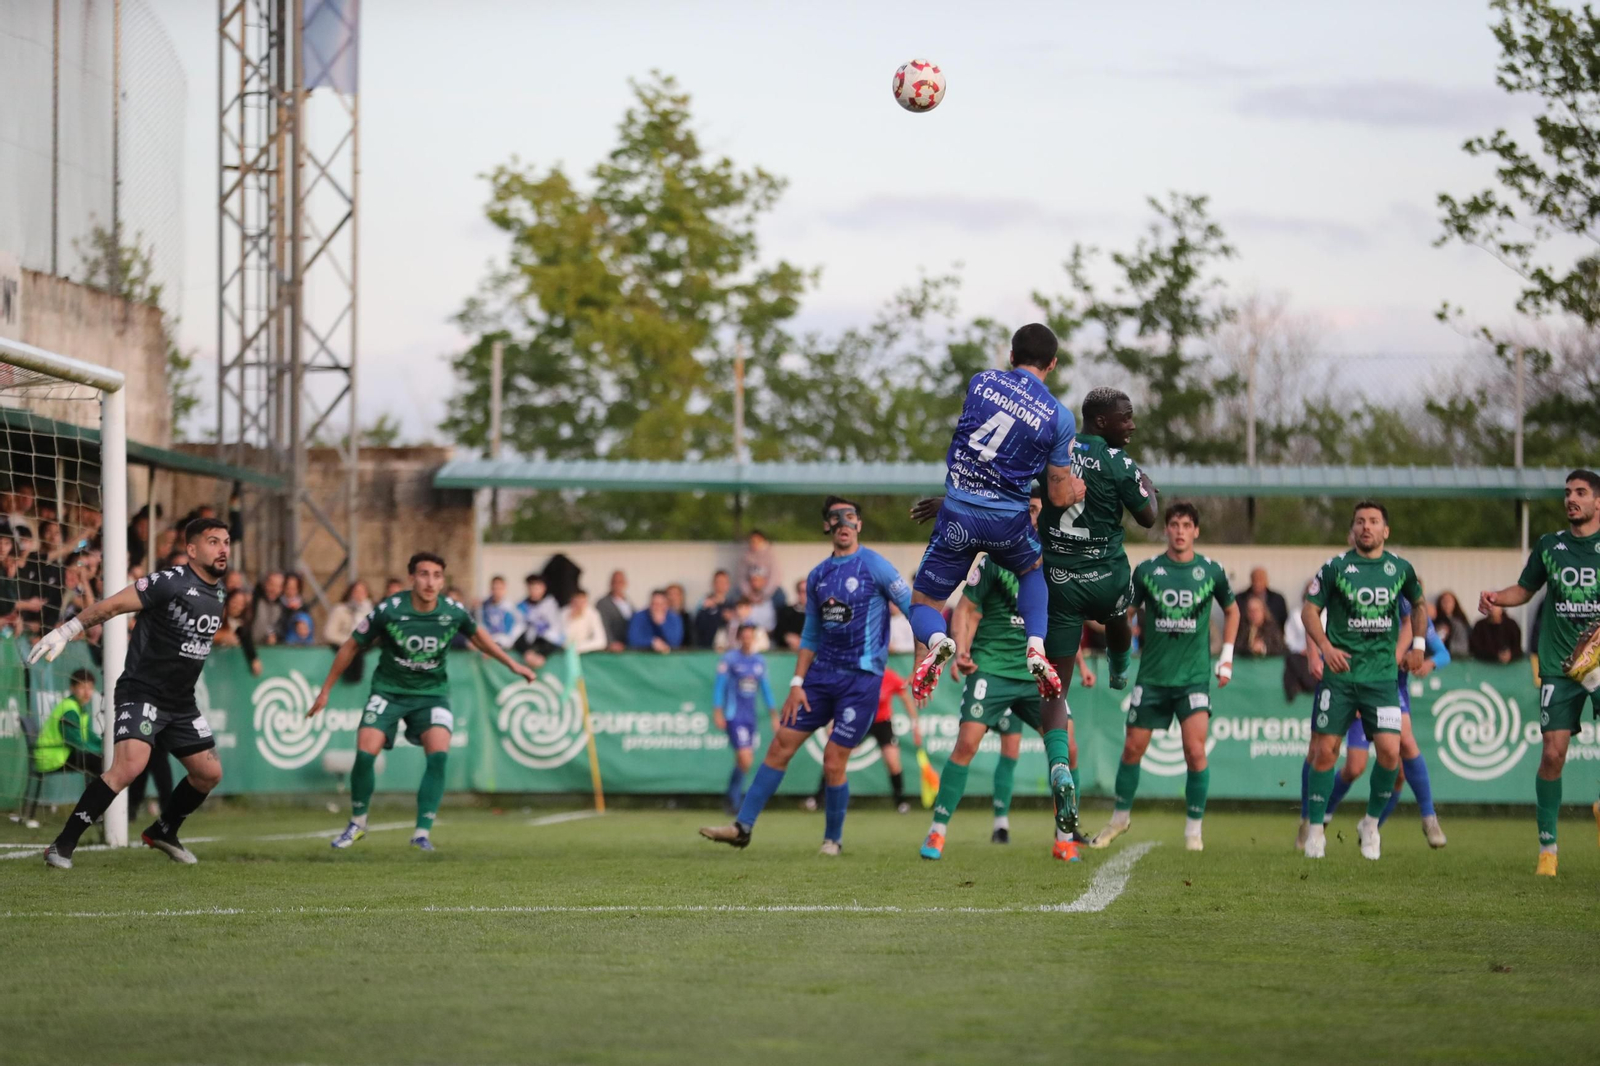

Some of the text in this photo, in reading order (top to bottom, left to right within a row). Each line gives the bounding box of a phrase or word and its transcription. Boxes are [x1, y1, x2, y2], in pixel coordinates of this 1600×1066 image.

[998, 378, 1055, 416] recoletas salud
[982, 387, 1042, 431] CARMONA
[1027, 404, 1051, 422] CARMEN
[968, 410, 1016, 463] 4
[970, 489, 1000, 499] GALICIA
[1560, 566, 1597, 586] OB
[1162, 588, 1195, 608] OB
[1357, 587, 1390, 606] OB
[196, 614, 220, 634] OB
[1155, 618, 1197, 629] columbia
[405, 634, 438, 653] OB
[974, 678, 988, 700] 6
[1540, 684, 1555, 707] 17
[366, 694, 388, 715] 21
[1320, 689, 1331, 711] 8
[588, 711, 709, 735] ourense
[621, 734, 702, 752] provincia
